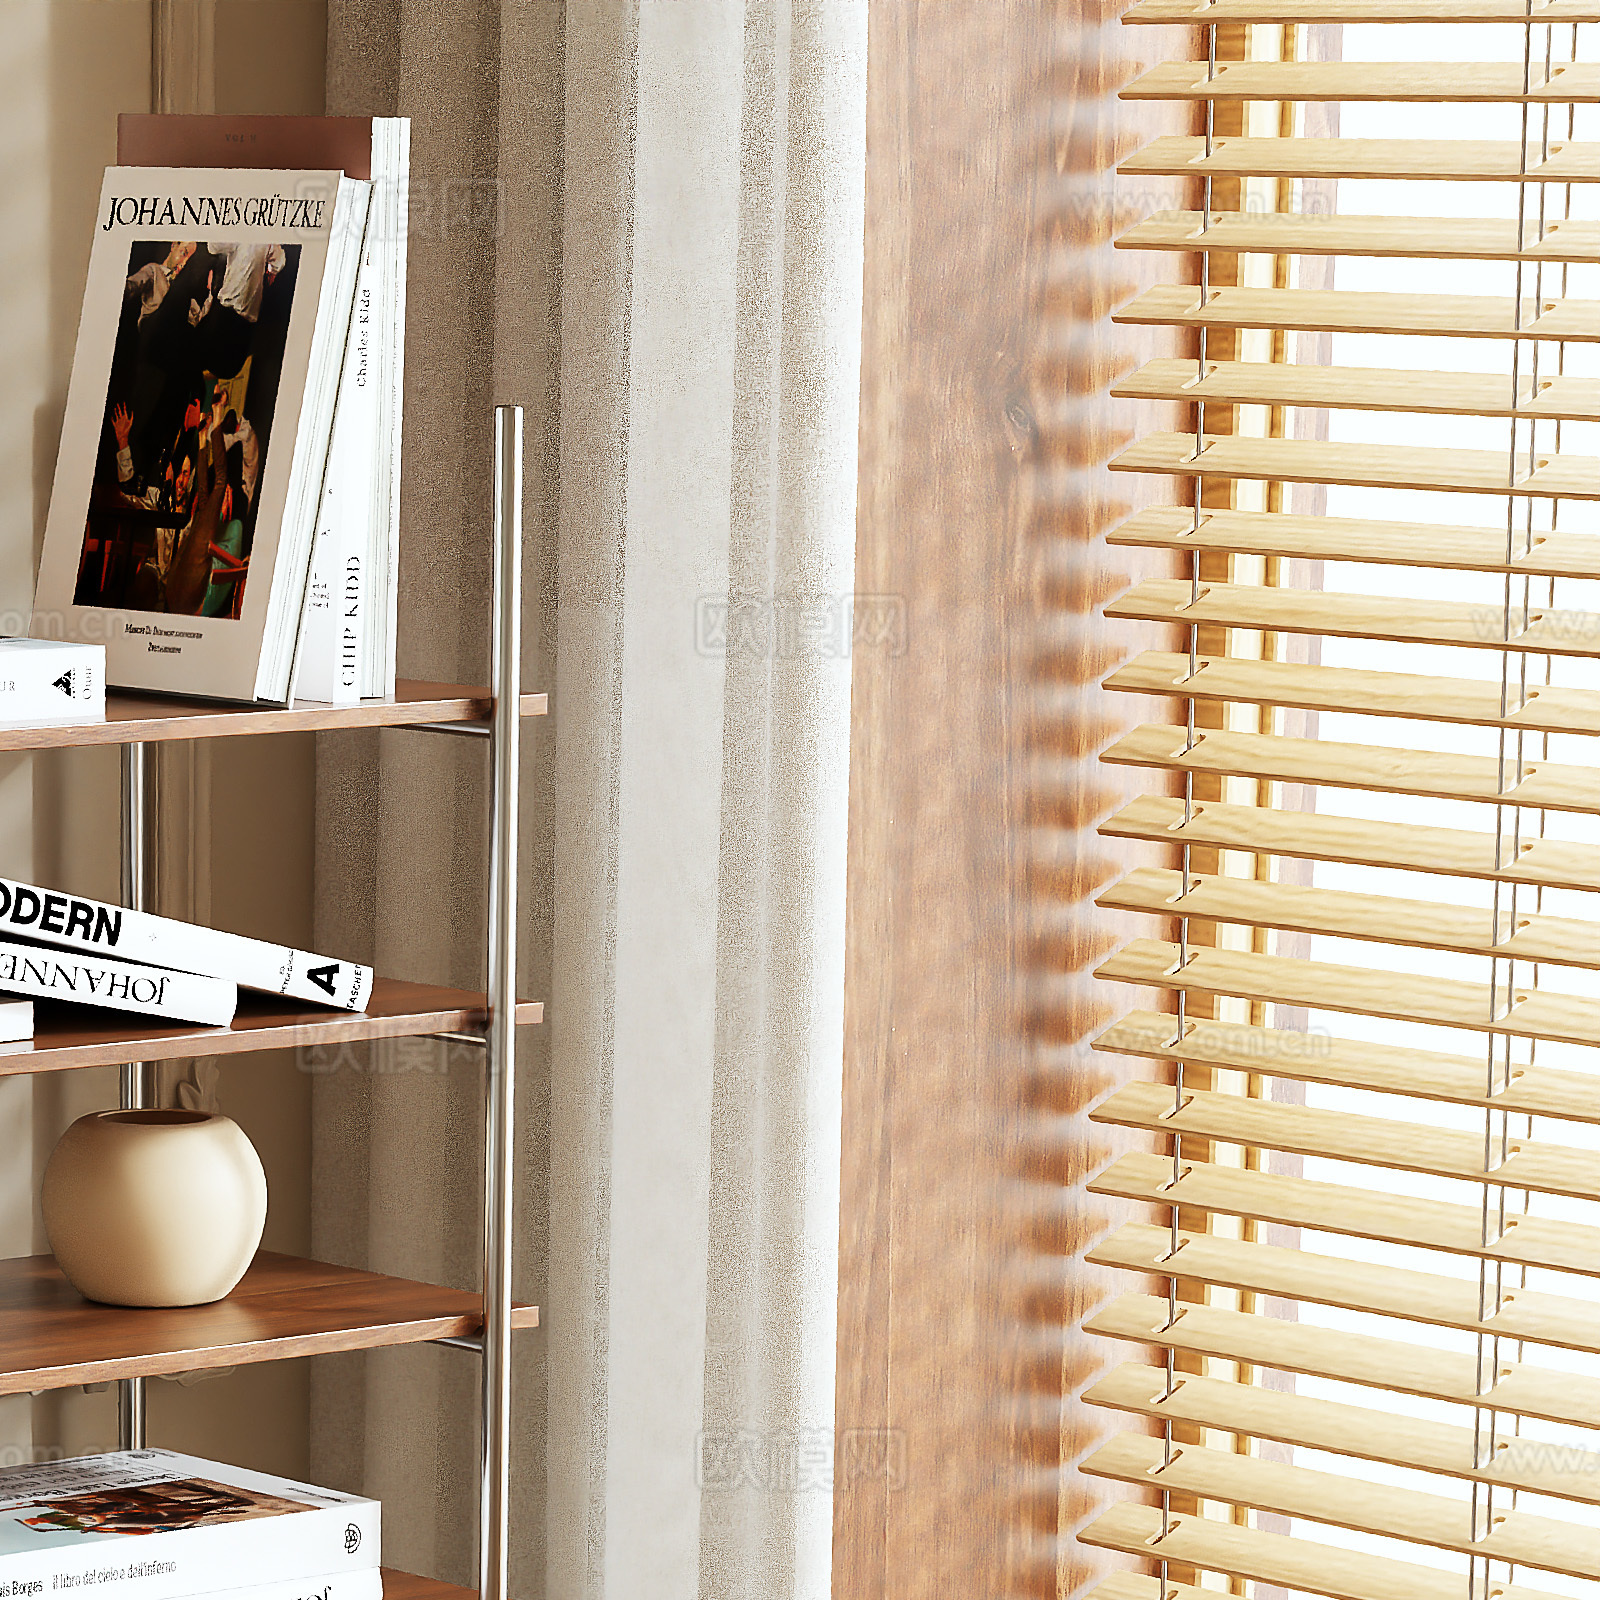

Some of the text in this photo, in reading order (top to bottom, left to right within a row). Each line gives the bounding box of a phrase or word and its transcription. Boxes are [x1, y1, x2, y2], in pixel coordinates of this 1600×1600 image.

[103, 193, 325, 231] JOHANNES GRÜTZKE
[307, 964, 339, 997] A
[12, 1578, 43, 1599] Borges
[60, 1570, 81, 1588] libro
[82, 1567, 96, 1585] del
